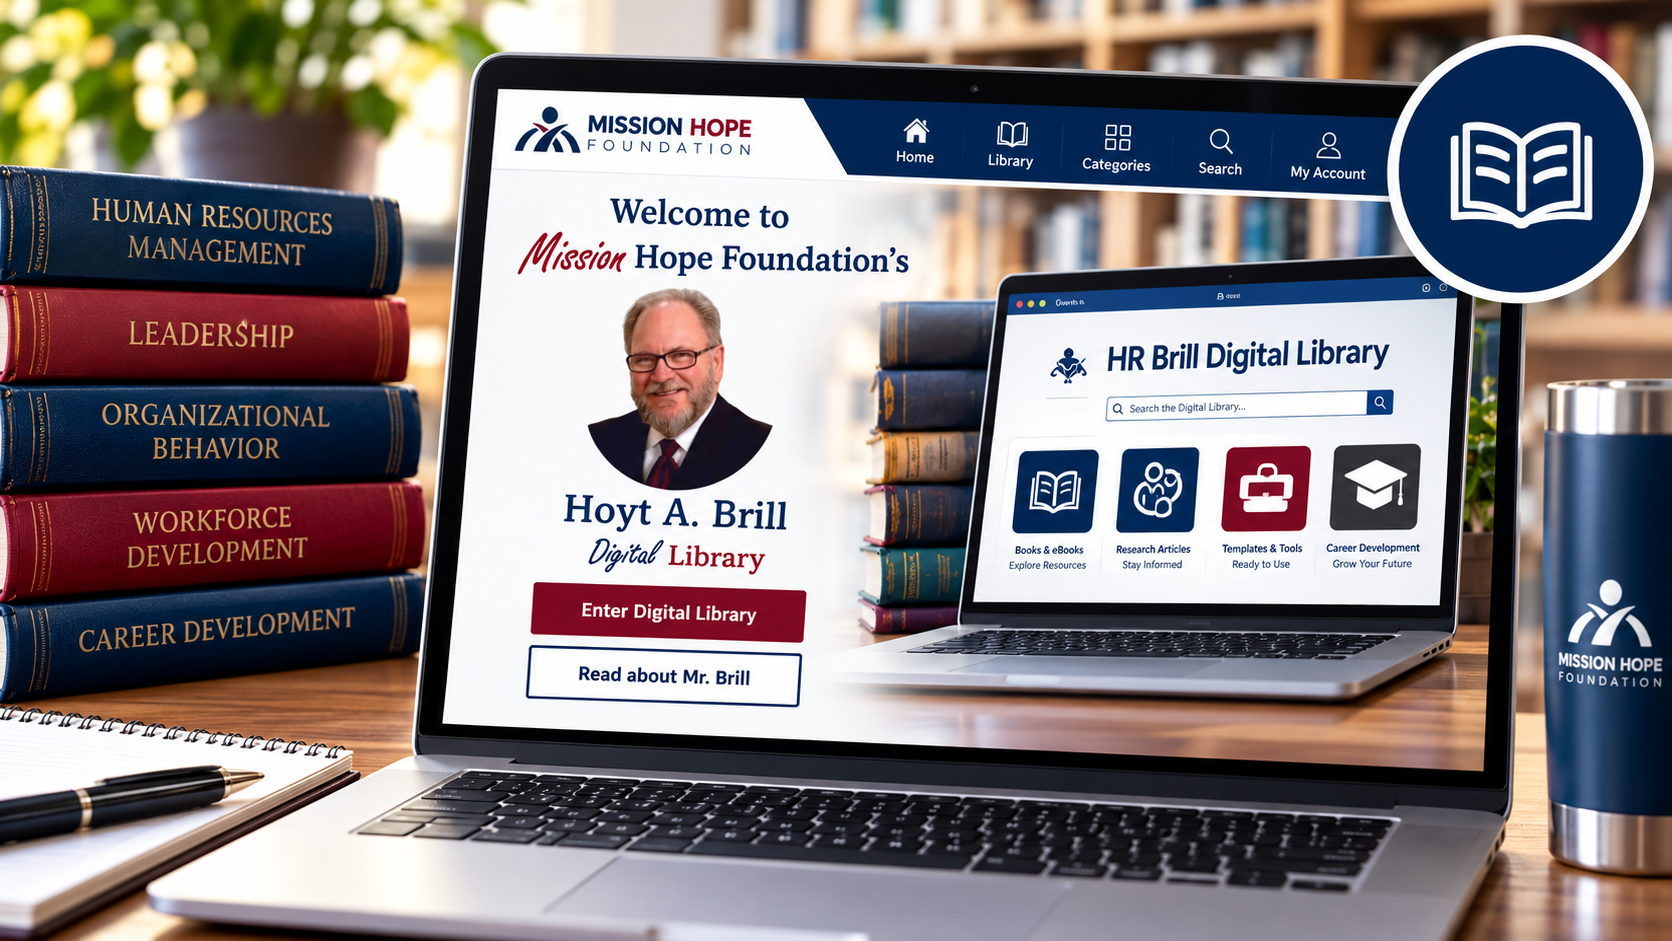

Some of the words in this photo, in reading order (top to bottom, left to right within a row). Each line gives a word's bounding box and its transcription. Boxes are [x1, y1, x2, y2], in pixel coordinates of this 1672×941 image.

[588, 114, 683, 136] MISSION
[690, 118, 752, 138] HOPE
[587, 139, 751, 156] FOUNDATION
[896, 151, 934, 163] Home
[988, 154, 1033, 170] Library
[1082, 157, 1151, 173] Categories
[1199, 162, 1242, 175] Search
[1291, 166, 1310, 180] My
[1313, 167, 1366, 180] Account
[92, 197, 192, 227] HUMAN
[201, 204, 333, 236] RESOURCES
[610, 198, 750, 228] Welcome
[760, 205, 789, 229] to
[127, 235, 305, 266] MANAGEMENT
[517, 231, 626, 275] Mission
[635, 244, 713, 276] Hope
[129, 320, 294, 349] LEADERSHIP
[1107, 345, 1145, 372] HR
[1152, 343, 1199, 371] Brill
[1206, 340, 1289, 374] Digital
[1296, 339, 1390, 371] Library
[101, 402, 330, 428] ORGANIZATIONAL
[1130, 404, 1159, 413] Search
[1162, 404, 1176, 412] the
[1179, 403, 1206, 414] Digital
[152, 437, 280, 460] BEHAVIOR
[133, 506, 292, 534] WORKFORCE
[563, 494, 651, 532] Hoyt
[662, 498, 698, 527] A.
[712, 499, 787, 530] Brill
[127, 537, 308, 569] DEVELOPMENT
[588, 538, 664, 573] Digital
[668, 544, 765, 575] Library
[1015, 546, 1041, 554] Books
[1043, 546, 1050, 554] &
[1052, 545, 1084, 554] eBooks
[1116, 545, 1155, 554] Research
[1157, 545, 1191, 554] Articles
[1222, 544, 1267, 555] Templates
[1270, 544, 1276, 553] &
[1279, 544, 1302, 553] Tools
[1326, 543, 1357, 553] Career
[1359, 543, 1420, 554] Development
[1009, 561, 1041, 571] Explore
[1043, 561, 1086, 570] Resources
[1122, 560, 1141, 571] Stay
[1143, 560, 1182, 569] Informed
[1232, 560, 1259, 570] Ready
[1262, 560, 1271, 568] to
[1273, 560, 1290, 568] Use
[1333, 559, 1357, 568] Grow
[1359, 559, 1380, 568] Your
[1382, 559, 1412, 568] Future
[582, 602, 628, 619] Enter
[634, 603, 690, 623] Digital
[696, 605, 757, 626] Library
[78, 622, 176, 653] CAREER
[183, 606, 356, 643] DEVELOPMENT
[1558, 652, 1615, 671] MISSION
[1620, 657, 1662, 672] HOPE
[578, 666, 622, 682] Read
[627, 667, 677, 684] about
[683, 669, 710, 684] Mr.
[716, 670, 750, 685] Brill
[1558, 671, 1662, 688] FOUNDATION
